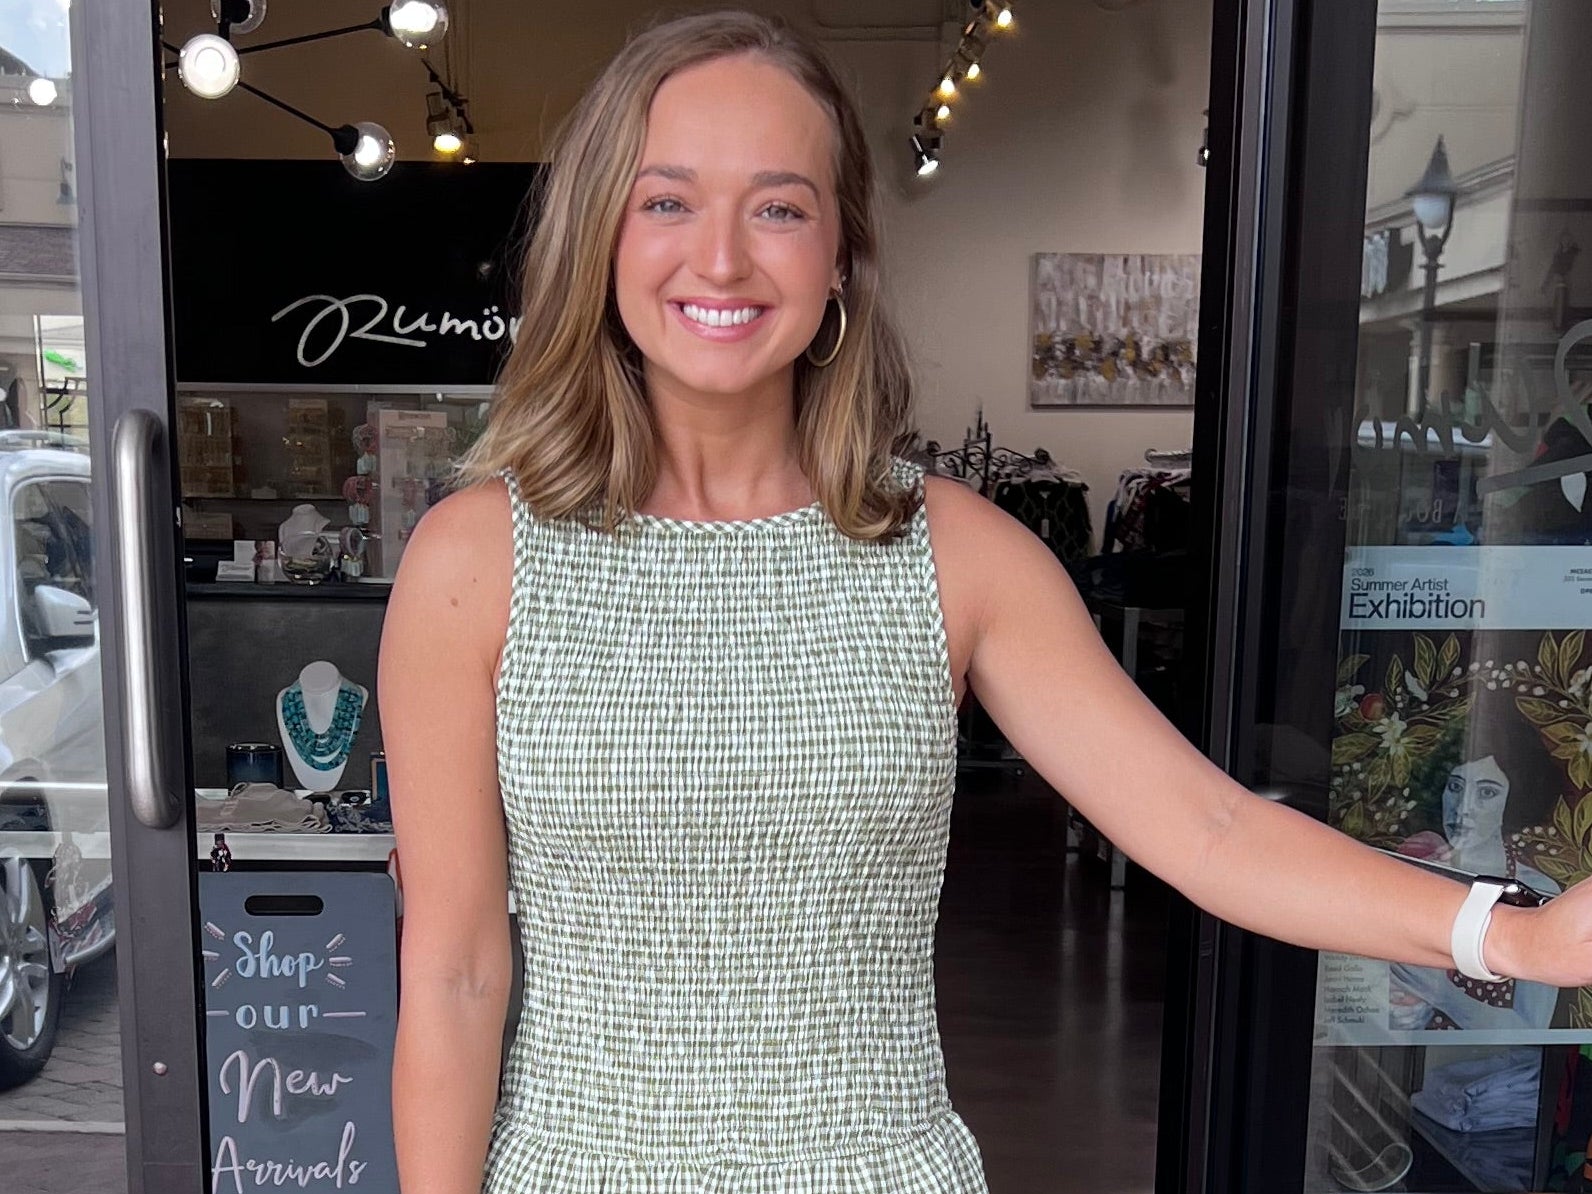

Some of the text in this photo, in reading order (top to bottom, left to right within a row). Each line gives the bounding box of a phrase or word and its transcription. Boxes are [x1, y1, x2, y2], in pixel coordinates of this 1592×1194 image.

[1350, 578, 1449, 591] Summer Artist
[1348, 592, 1486, 619] Exhibition
[233, 930, 324, 988] Shop
[235, 1004, 319, 1029] our
[219, 1050, 354, 1123] New
